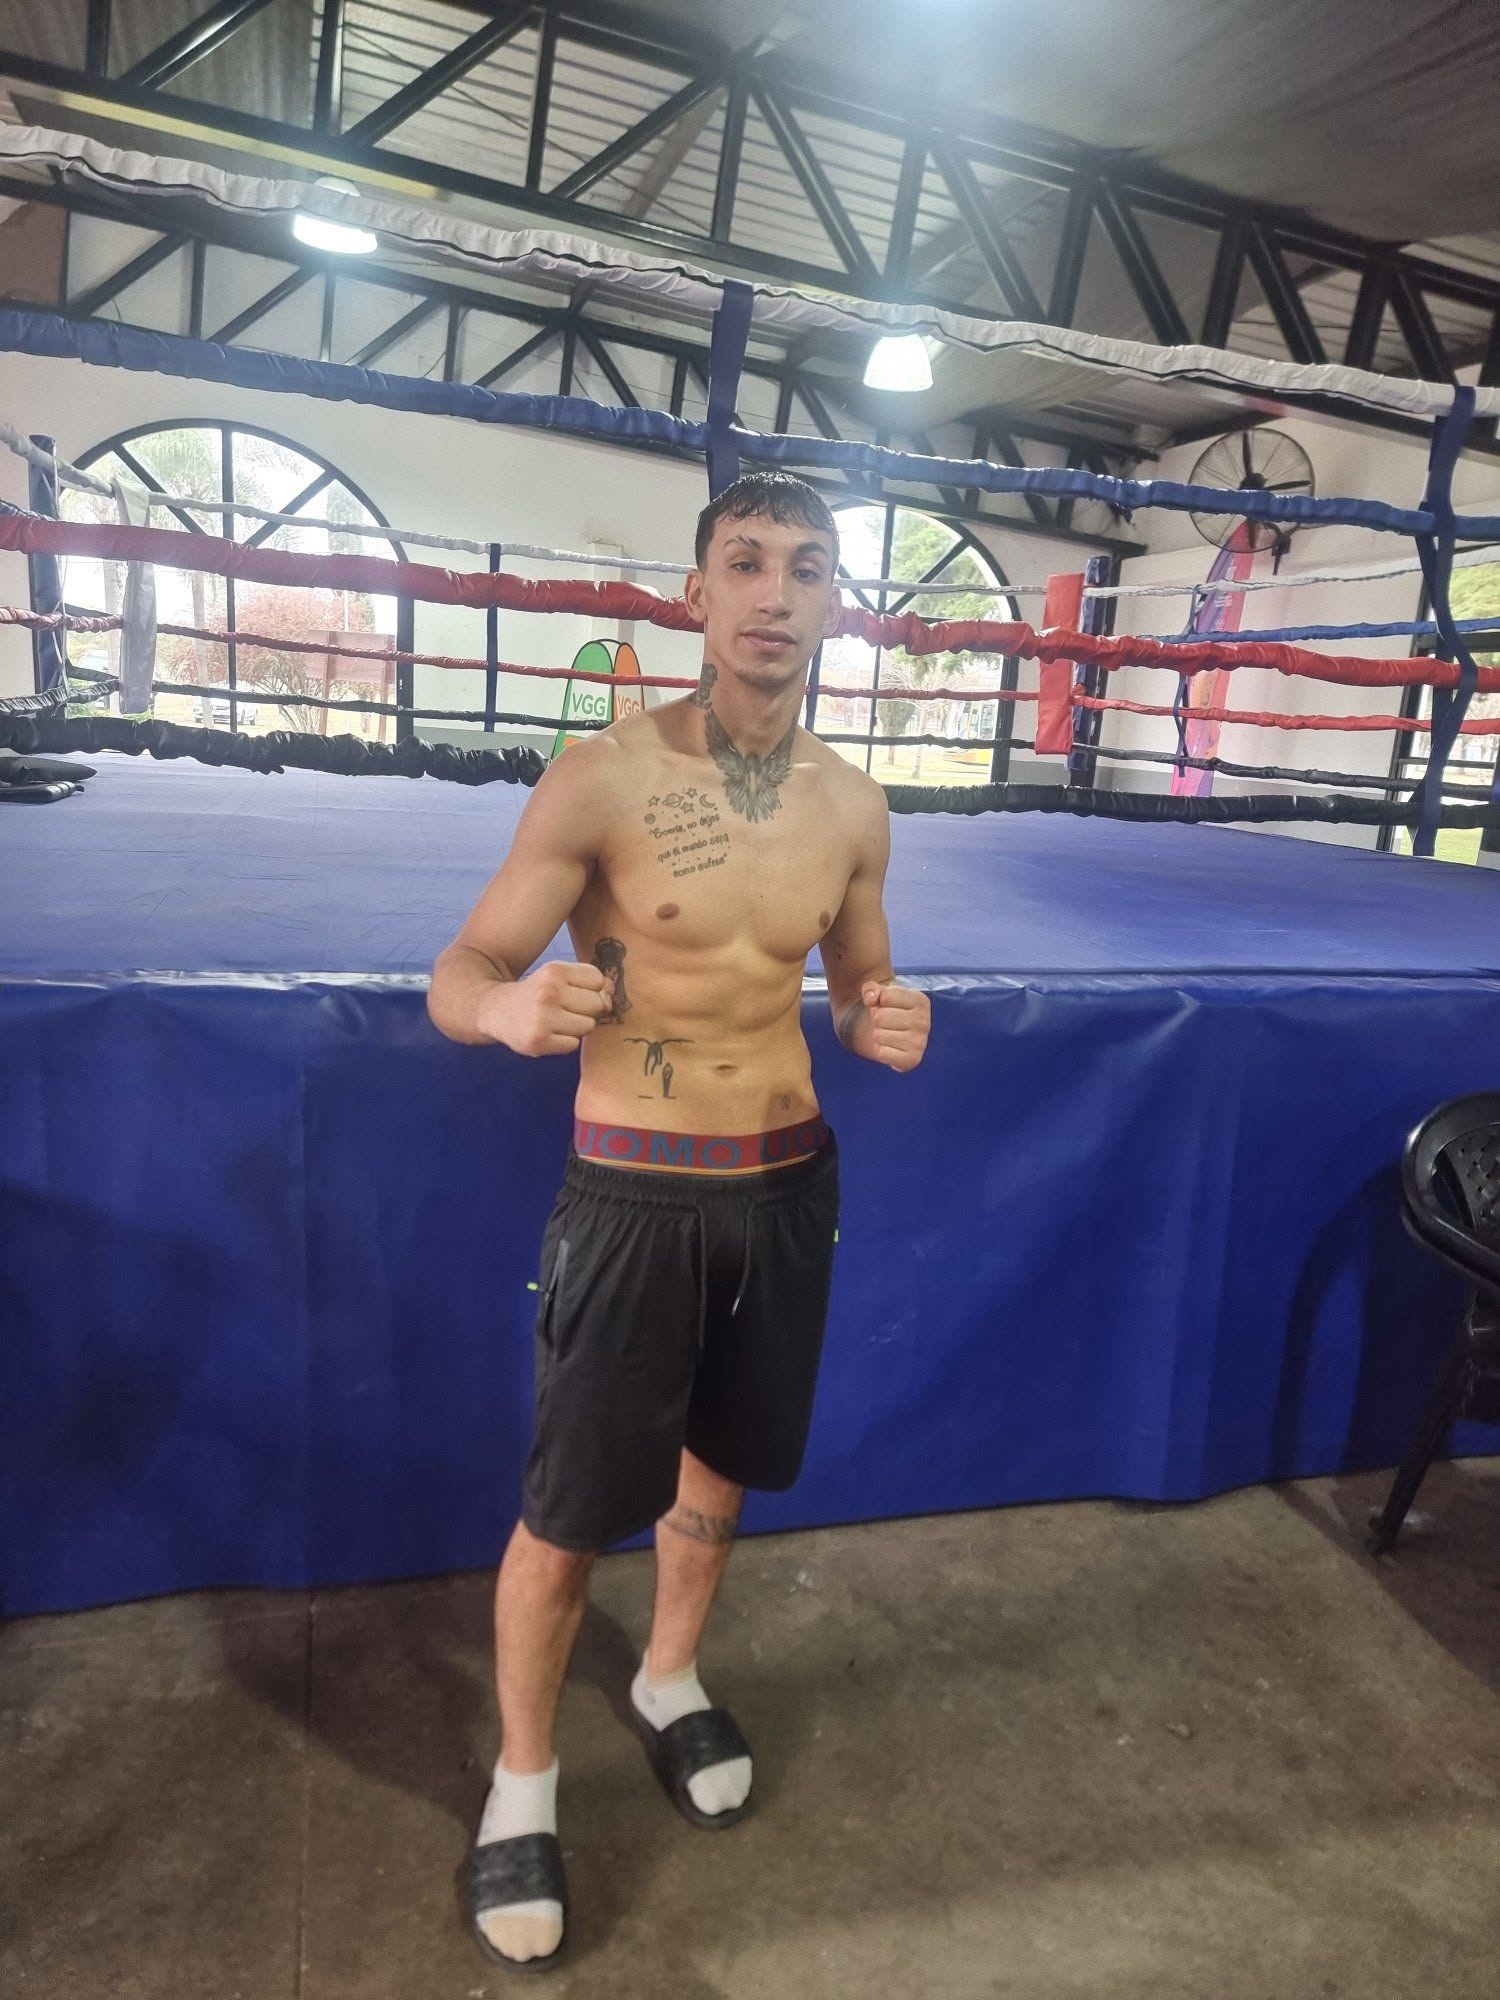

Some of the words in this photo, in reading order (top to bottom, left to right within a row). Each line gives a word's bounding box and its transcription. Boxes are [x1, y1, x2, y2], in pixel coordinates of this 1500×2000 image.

[573, 692, 606, 717] VGG
[617, 695, 640, 715] VGG
[576, 1122, 741, 1169] UOMO
